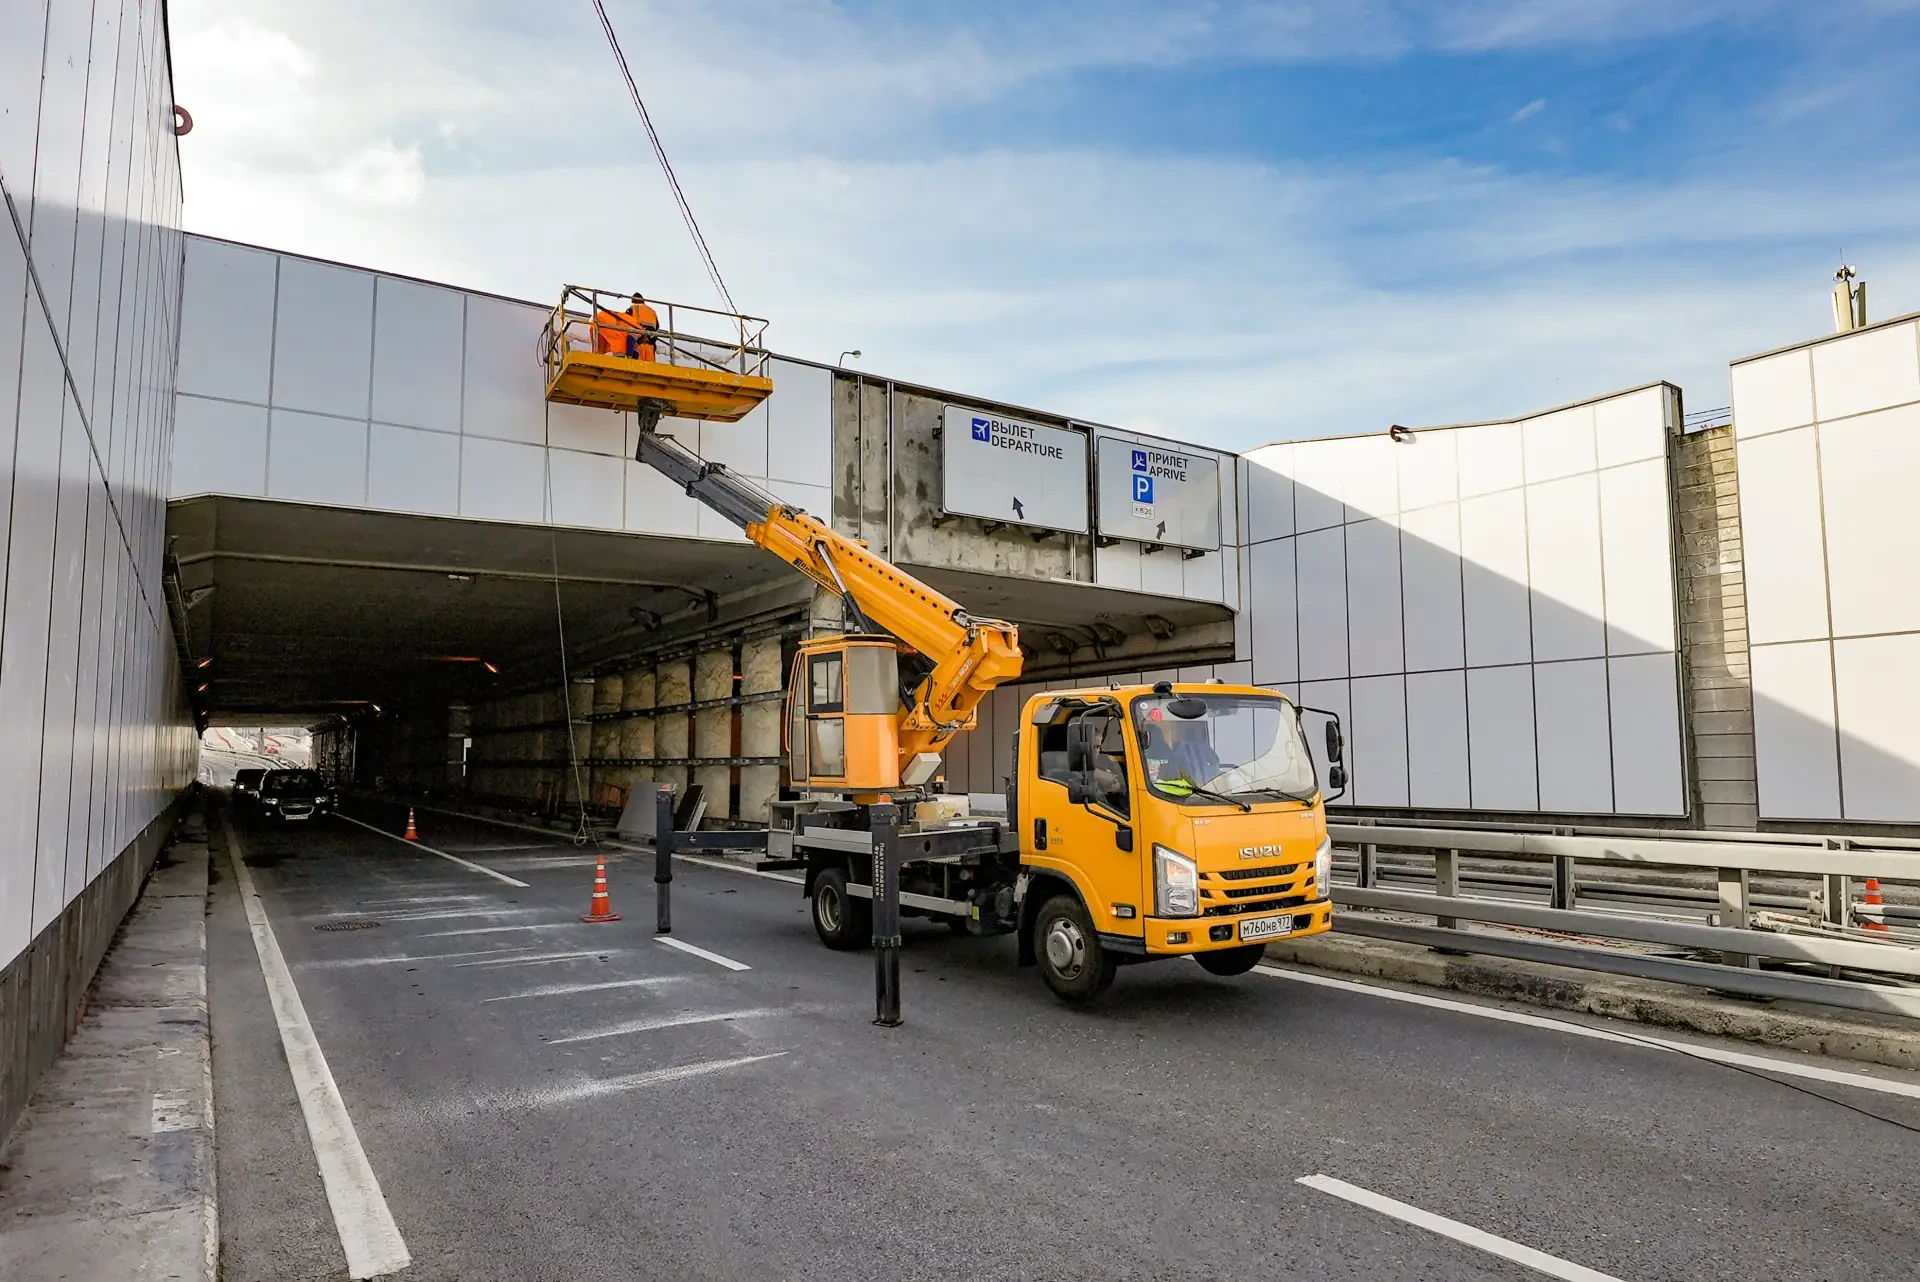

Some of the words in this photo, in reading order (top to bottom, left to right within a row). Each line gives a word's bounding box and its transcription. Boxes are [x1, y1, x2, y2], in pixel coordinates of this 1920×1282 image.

[991, 420, 1034, 439] ВЫЛЕТ
[991, 434, 1063, 459] DEPARTURE
[1148, 451, 1188, 469] ПРИЛЕТ
[1149, 465, 1186, 482] APRIVE
[1137, 477, 1149, 500] P
[1239, 845, 1282, 860] ISUZU
[1277, 916, 1290, 928] 977
